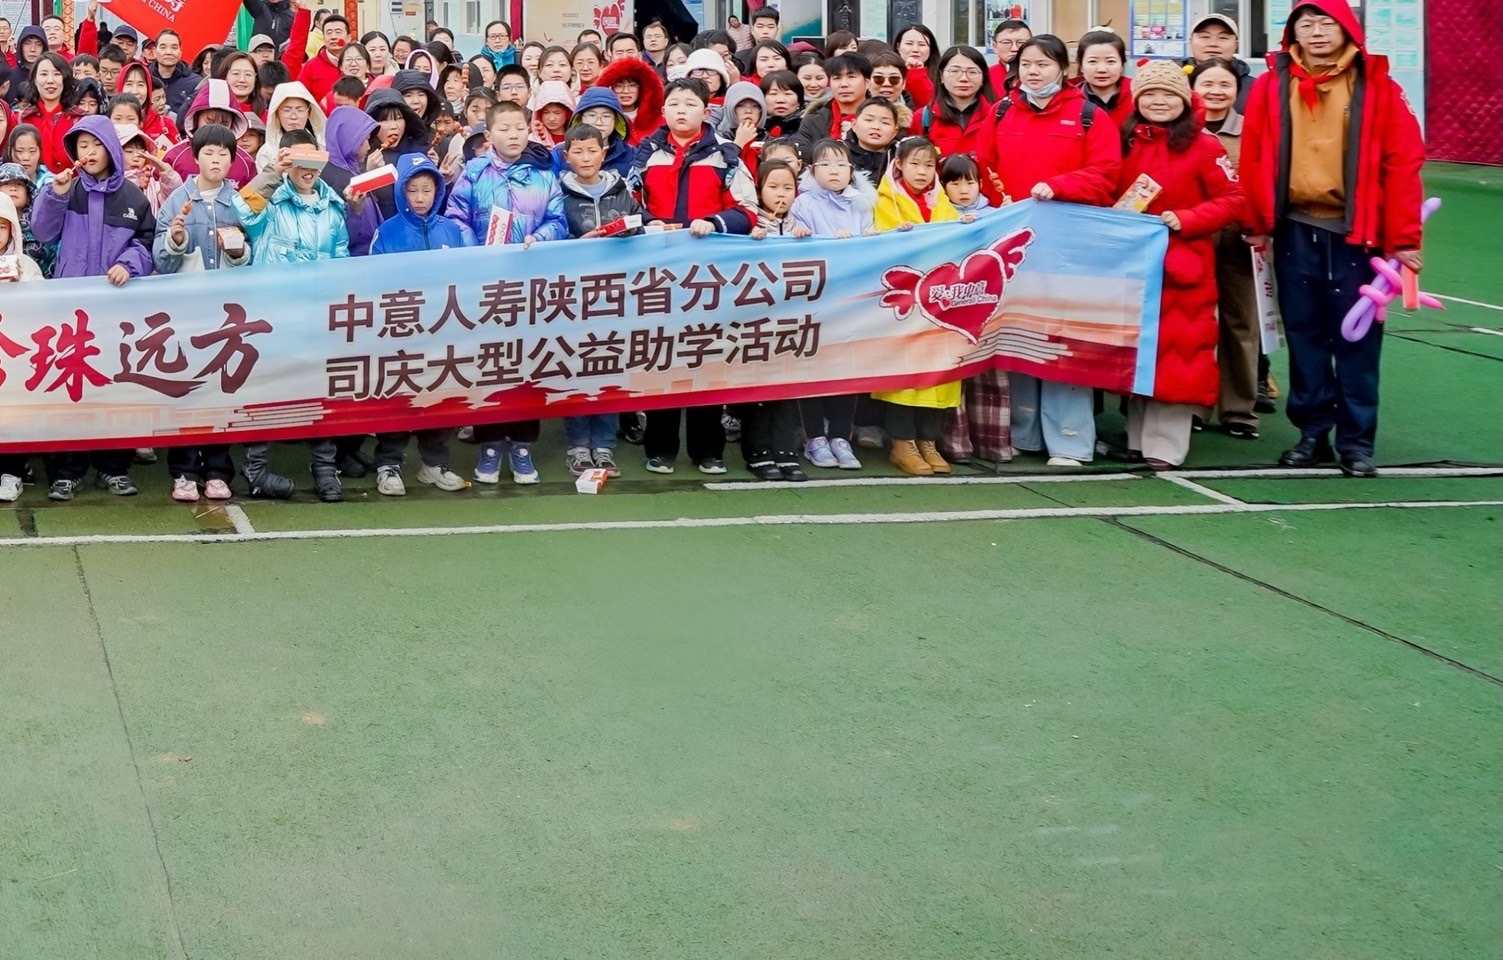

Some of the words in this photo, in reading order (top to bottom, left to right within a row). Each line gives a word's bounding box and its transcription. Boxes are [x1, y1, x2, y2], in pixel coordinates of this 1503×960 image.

[148, 0, 176, 23] CHINA
[328, 258, 828, 344] 中意人寿陕西省分公司
[326, 313, 823, 401] 司庆大型公益助学活动
